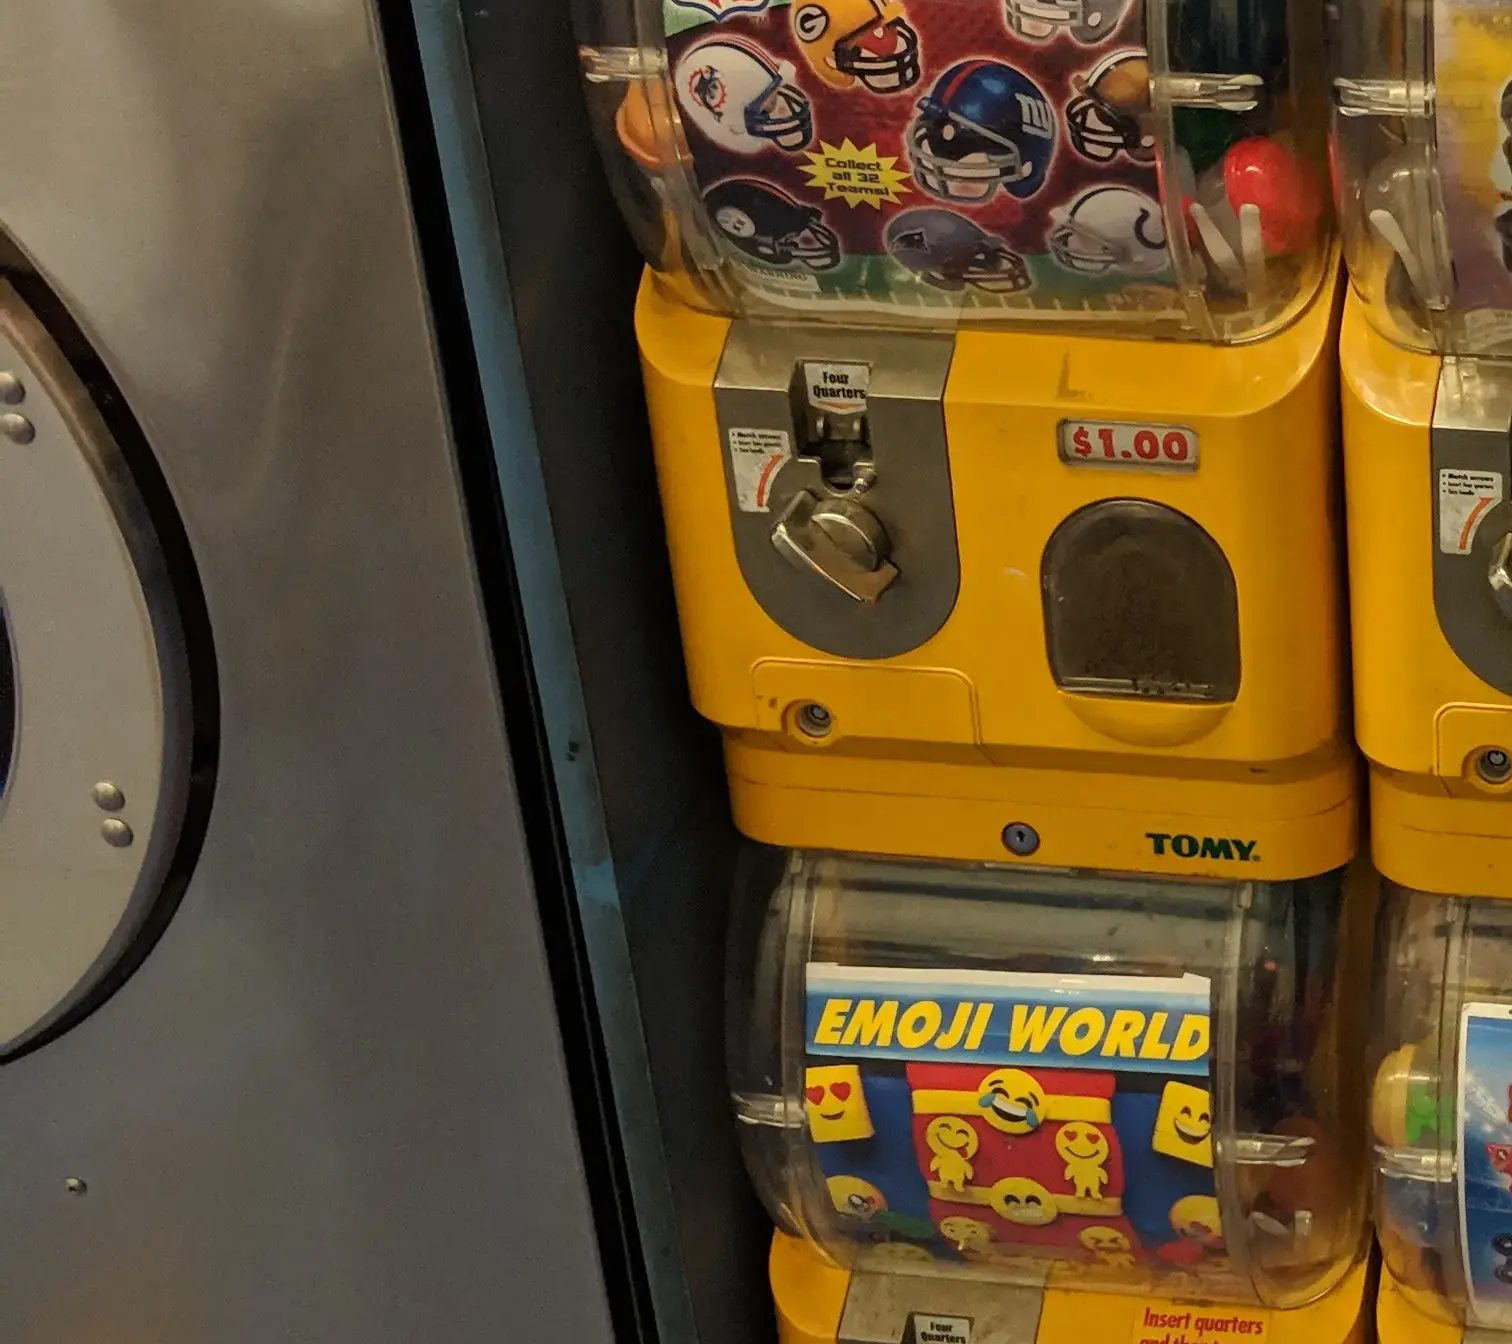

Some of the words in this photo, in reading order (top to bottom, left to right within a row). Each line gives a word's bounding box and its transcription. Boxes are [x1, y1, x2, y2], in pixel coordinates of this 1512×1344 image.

[825, 157, 883, 171] Collect
[832, 171, 852, 181] all
[857, 172, 880, 183] 32
[826, 182, 889, 196] Teams!
[822, 371, 849, 385] Four
[813, 385, 866, 399] Quarters
[1073, 426, 1189, 462] $1.00
[814, 998, 994, 1051] EMOJI
[1007, 1004, 1210, 1062] WORLD
[1144, 1306, 1191, 1330] Insert
[1195, 1315, 1263, 1337] quarters
[921, 1332, 966, 1344] Quarters
